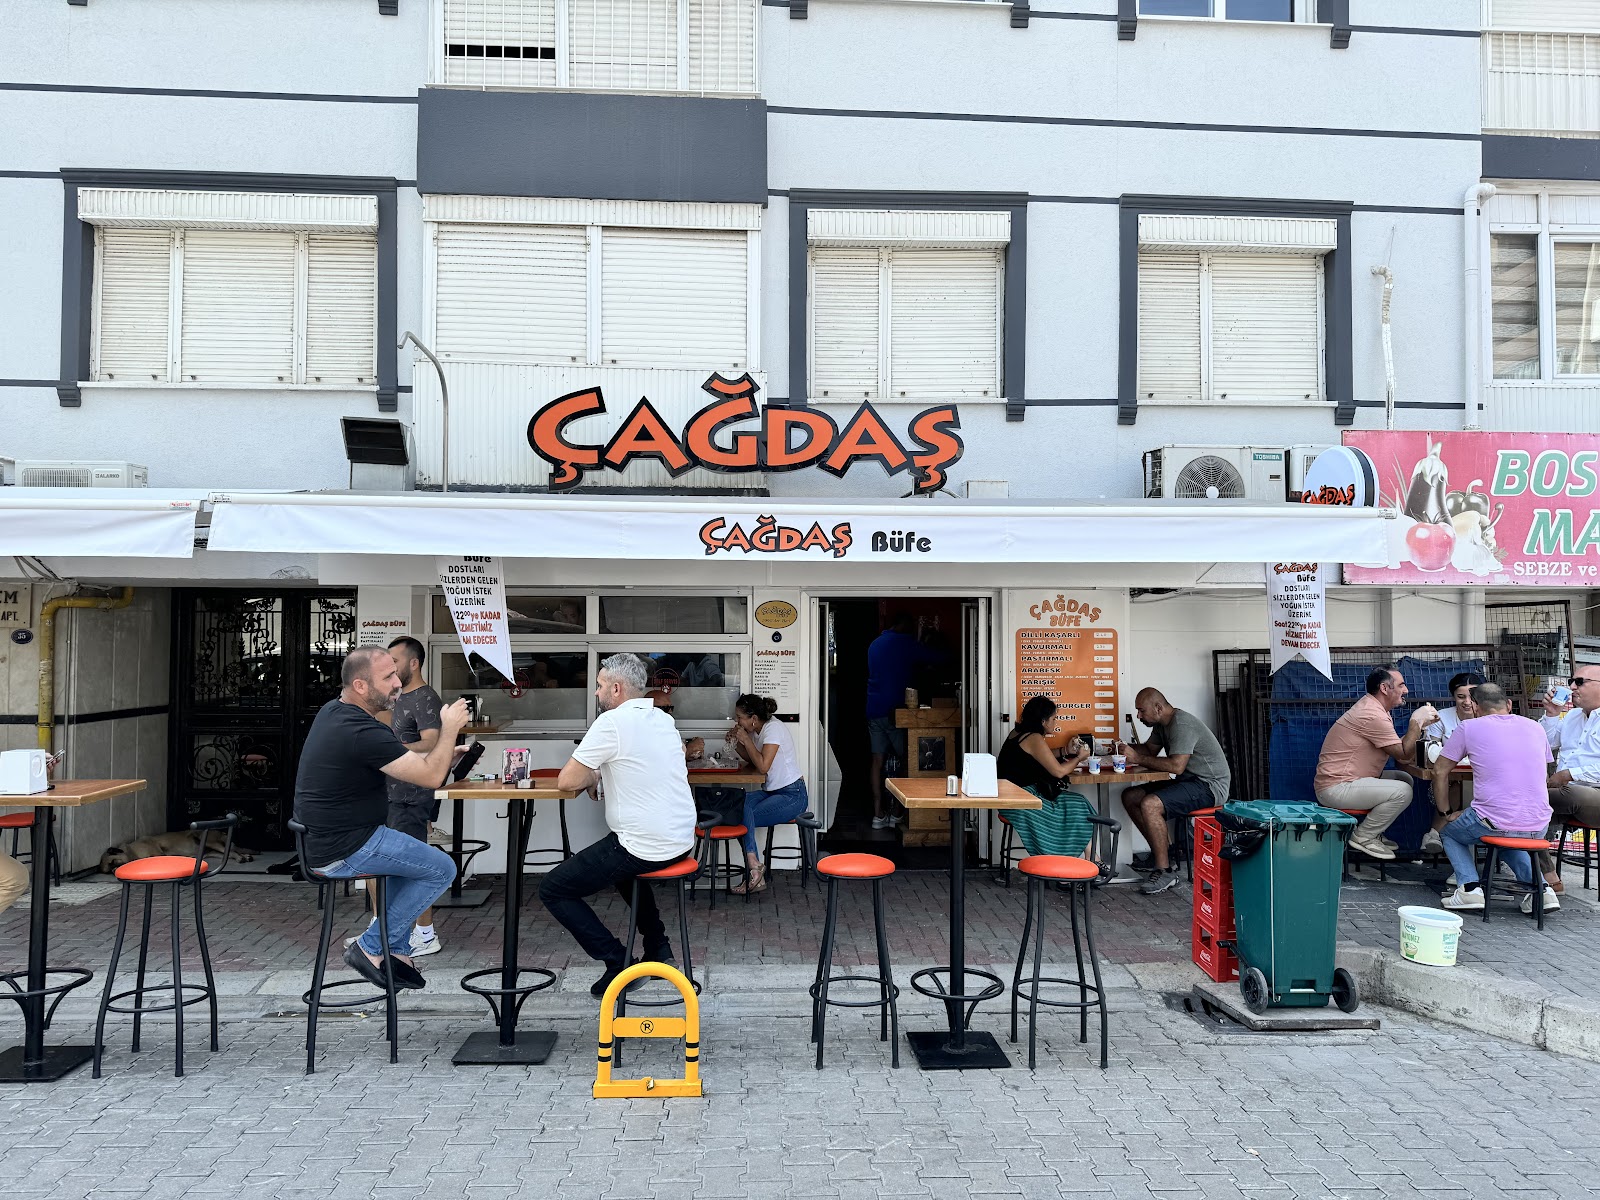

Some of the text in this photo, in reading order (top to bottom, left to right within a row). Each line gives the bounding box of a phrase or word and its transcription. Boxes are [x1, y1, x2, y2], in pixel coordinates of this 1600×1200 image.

[526, 371, 964, 493] ÇAĞDAŞ
[698, 513, 932, 558] ÇAĞDAŞ Büfe
[448, 565, 485, 574] DOSTLARI
[1513, 561, 1598, 577] SEBZE ve
[477, 576, 498, 585] GELEN
[1296, 574, 1316, 582] Büfe
[445, 585, 493, 595] YOĞUN İSTEK
[0, 590, 18, 604] M
[454, 596, 486, 606] ÜZERİNE
[1029, 594, 1102, 623] ÇAĞDAŞ
[1, 610, 19, 621] APT.
[480, 611, 501, 620] KADAR
[1049, 613, 1082, 627] BÜFE
[17, 632, 26, 640] 35
[1044, 631, 1081, 639] KAŞARLI
[1020, 678, 1057, 686] KARIŞIK
